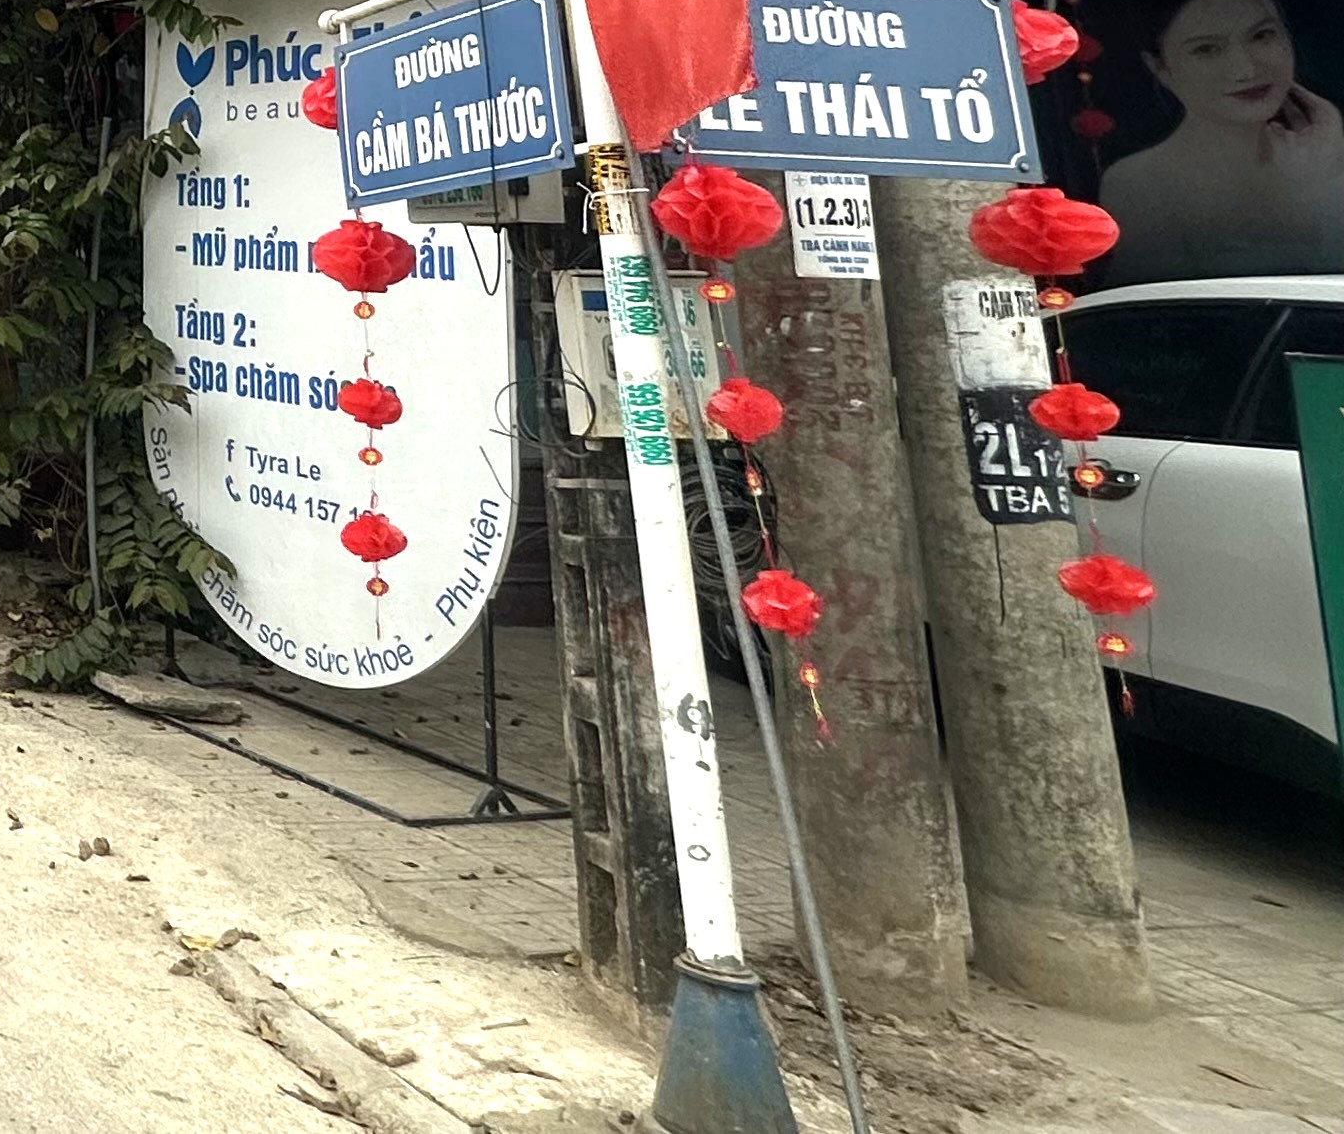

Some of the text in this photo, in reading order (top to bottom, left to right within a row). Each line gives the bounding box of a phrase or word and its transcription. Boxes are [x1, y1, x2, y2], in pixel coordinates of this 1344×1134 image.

[761, 0, 907, 49] ĐƯỜNG
[394, 33, 481, 90] ĐƯỜNG
[355, 78, 548, 176] CẦM BÁ THƯỚC
[775, 73, 910, 139] THÁI
[919, 68, 996, 145] TỔ
[176, 167, 250, 209] Tầng 1:
[192, 227, 226, 268] Mỹ
[234, 224, 298, 272] phẩm
[175, 298, 257, 347] Tầng 2:
[235, 362, 301, 406] chăm
[245, 446, 289, 475] Tyra
[296, 457, 322, 482] Le
[249, 484, 297, 514] 0944
[305, 496, 340, 524] 157
[979, 484, 1053, 514] TBA
[257, 621, 298, 661] sóc
[305, 642, 350, 676] sức
[435, 571, 483, 627] Phụ
[468, 497, 504, 569] kiện
